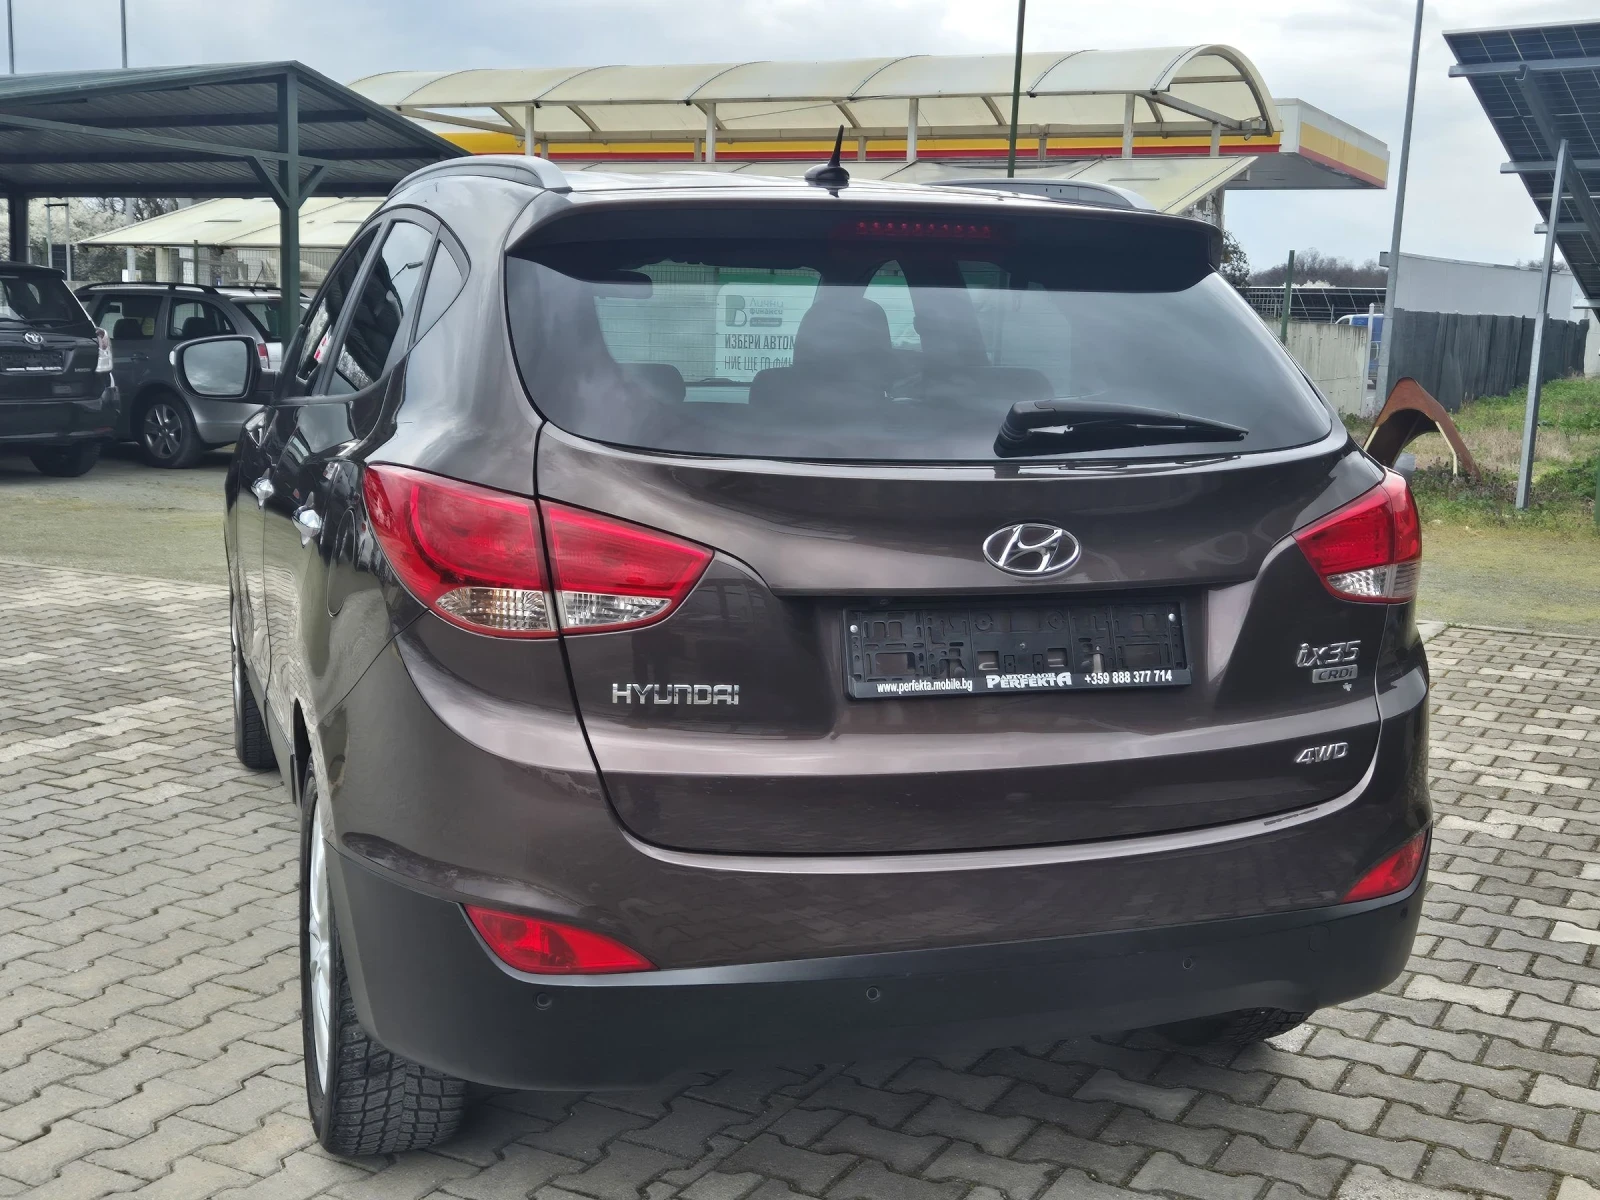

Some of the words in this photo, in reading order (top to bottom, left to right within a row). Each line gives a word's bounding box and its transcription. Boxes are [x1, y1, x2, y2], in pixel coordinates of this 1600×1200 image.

[724, 334, 760, 349] ИЗБЕРИ
[724, 355, 741, 370] НИЕ
[743, 356, 758, 372] ЩЕ
[760, 356, 771, 370] ГО
[1296, 640, 1361, 667] ix35
[985, 672, 1073, 689] PERFEKTA
[1084, 671, 1110, 685] +359
[1112, 671, 1131, 684] 888
[1133, 670, 1151, 683] 377
[1153, 669, 1173, 682] 714
[1318, 667, 1354, 681] CRDi
[612, 683, 740, 705] HYUNDAI
[876, 677, 973, 695] www.perfekta.mobile.bg
[1296, 741, 1349, 764] 4WD
